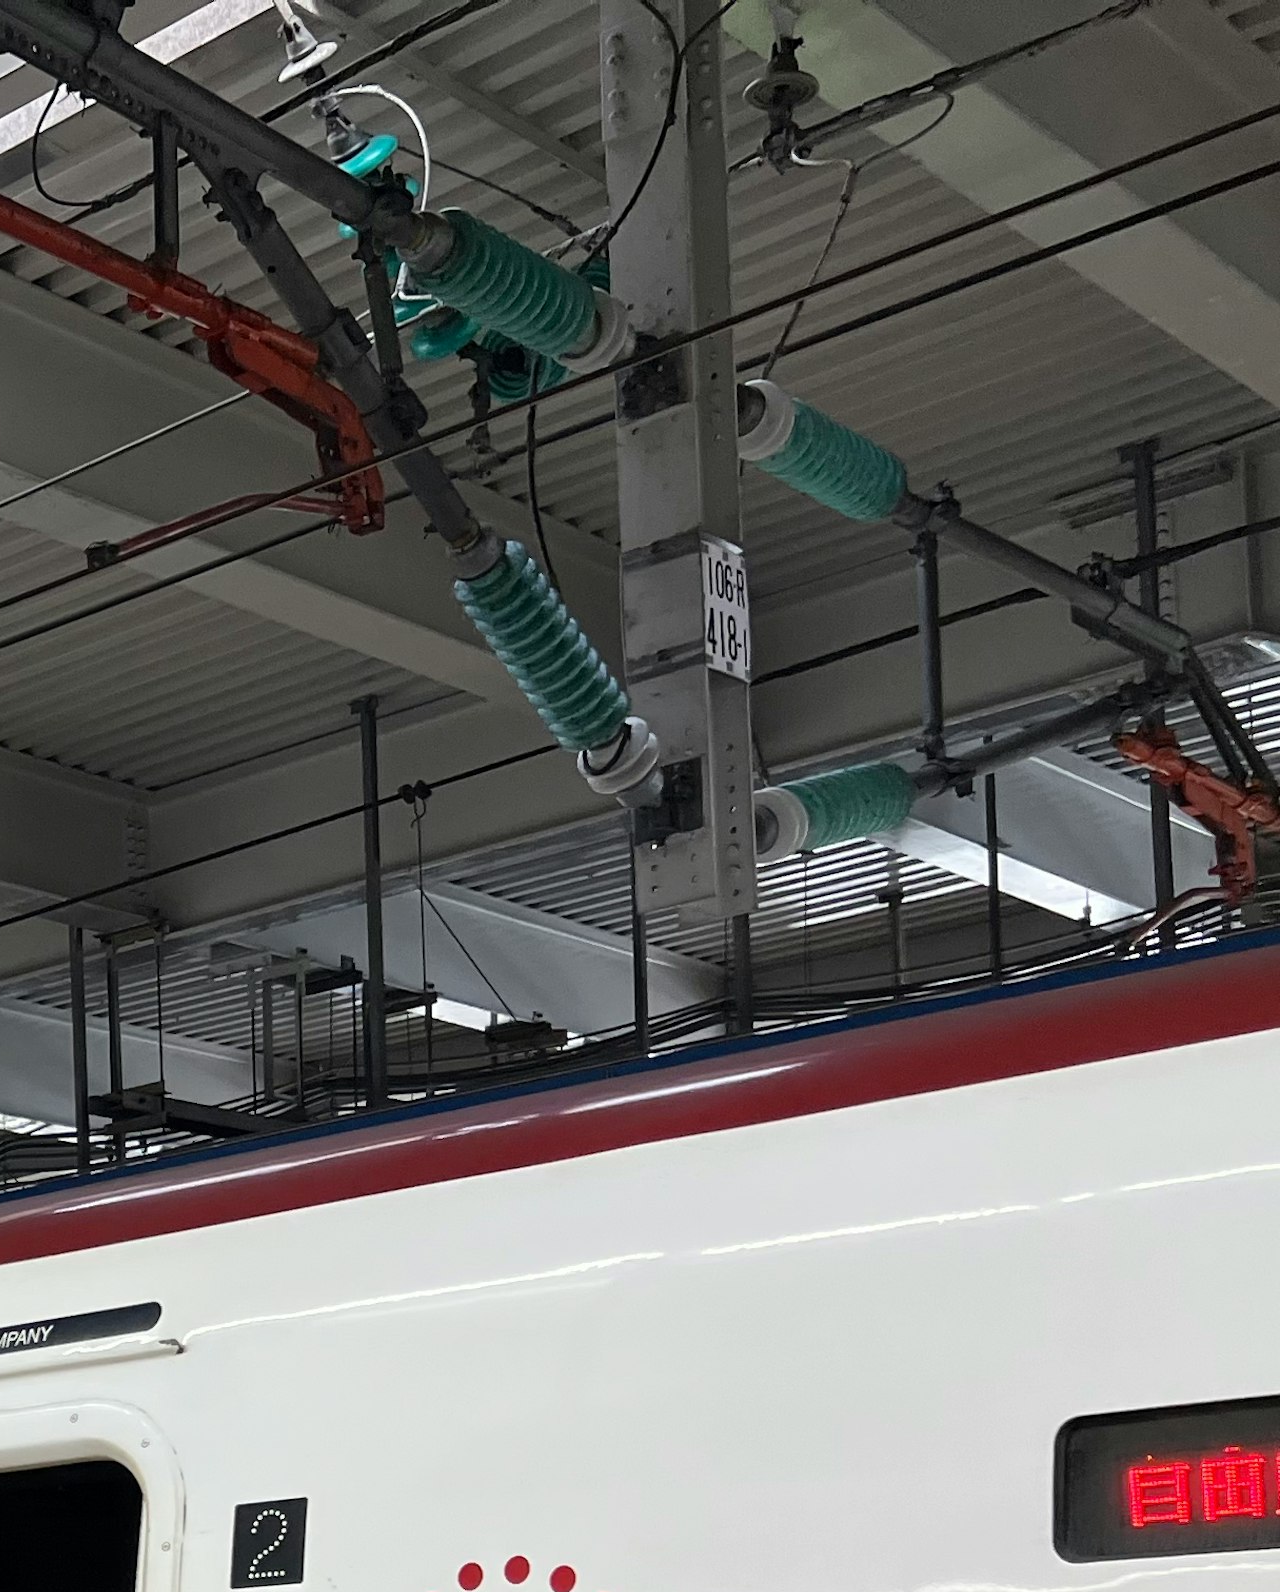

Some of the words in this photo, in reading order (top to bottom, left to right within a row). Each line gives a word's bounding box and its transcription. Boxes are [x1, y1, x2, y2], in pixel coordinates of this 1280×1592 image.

[707, 607, 748, 668] 418-1
[1128, 1446, 1280, 1528] 自由
[247, 1508, 288, 1580] 2
